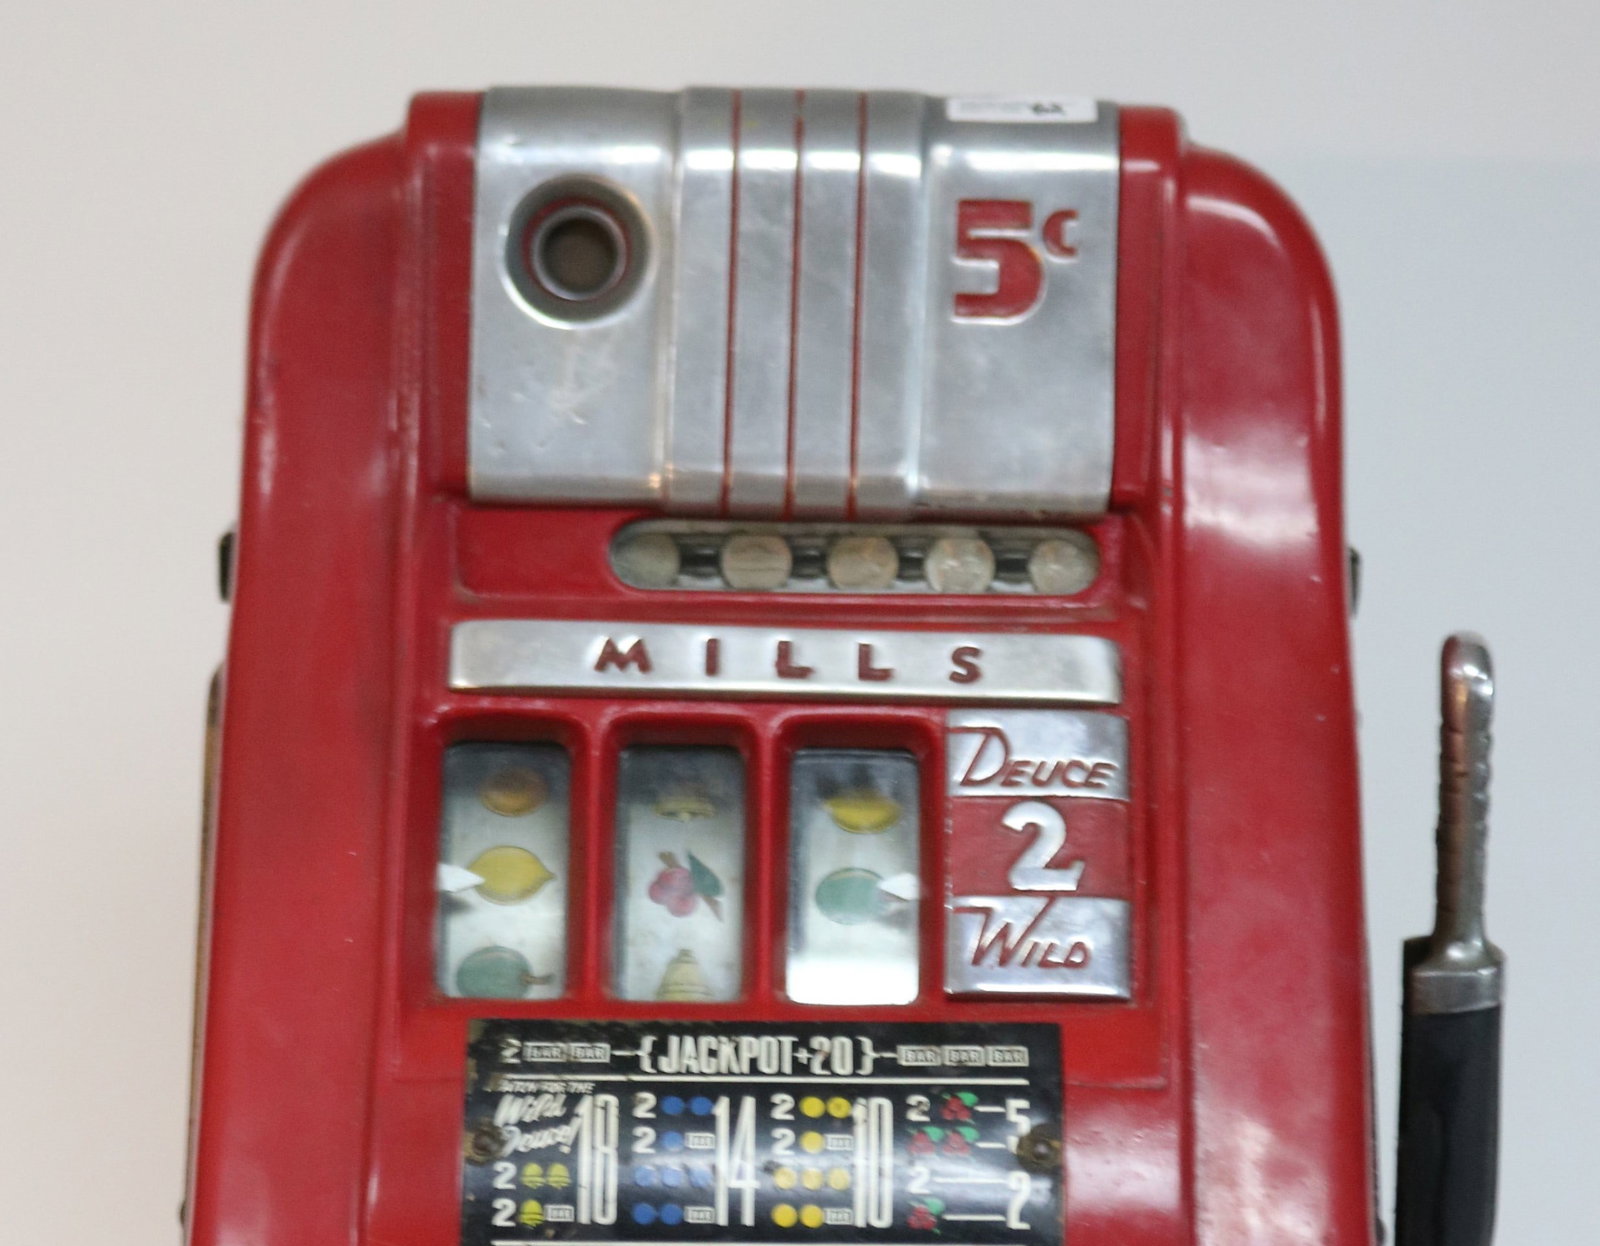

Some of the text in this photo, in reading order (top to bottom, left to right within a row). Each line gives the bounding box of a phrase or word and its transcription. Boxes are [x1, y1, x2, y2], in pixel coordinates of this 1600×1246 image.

[594, 638, 984, 684] MILLS
[1002, 800, 1085, 891] 2
[632, 1091, 657, 1119] 2
[770, 1093, 796, 1121] 2
[905, 1094, 931, 1122] 2
[631, 1126, 657, 1154] 2
[770, 1128, 796, 1155] 2
[492, 1161, 516, 1189] 2
[712, 1096, 760, 1227] 14
[852, 1097, 894, 1228] 10
[907, 1166, 931, 1194] 2
[491, 1198, 516, 1227] 2
[1006, 1171, 1031, 1230] 2
